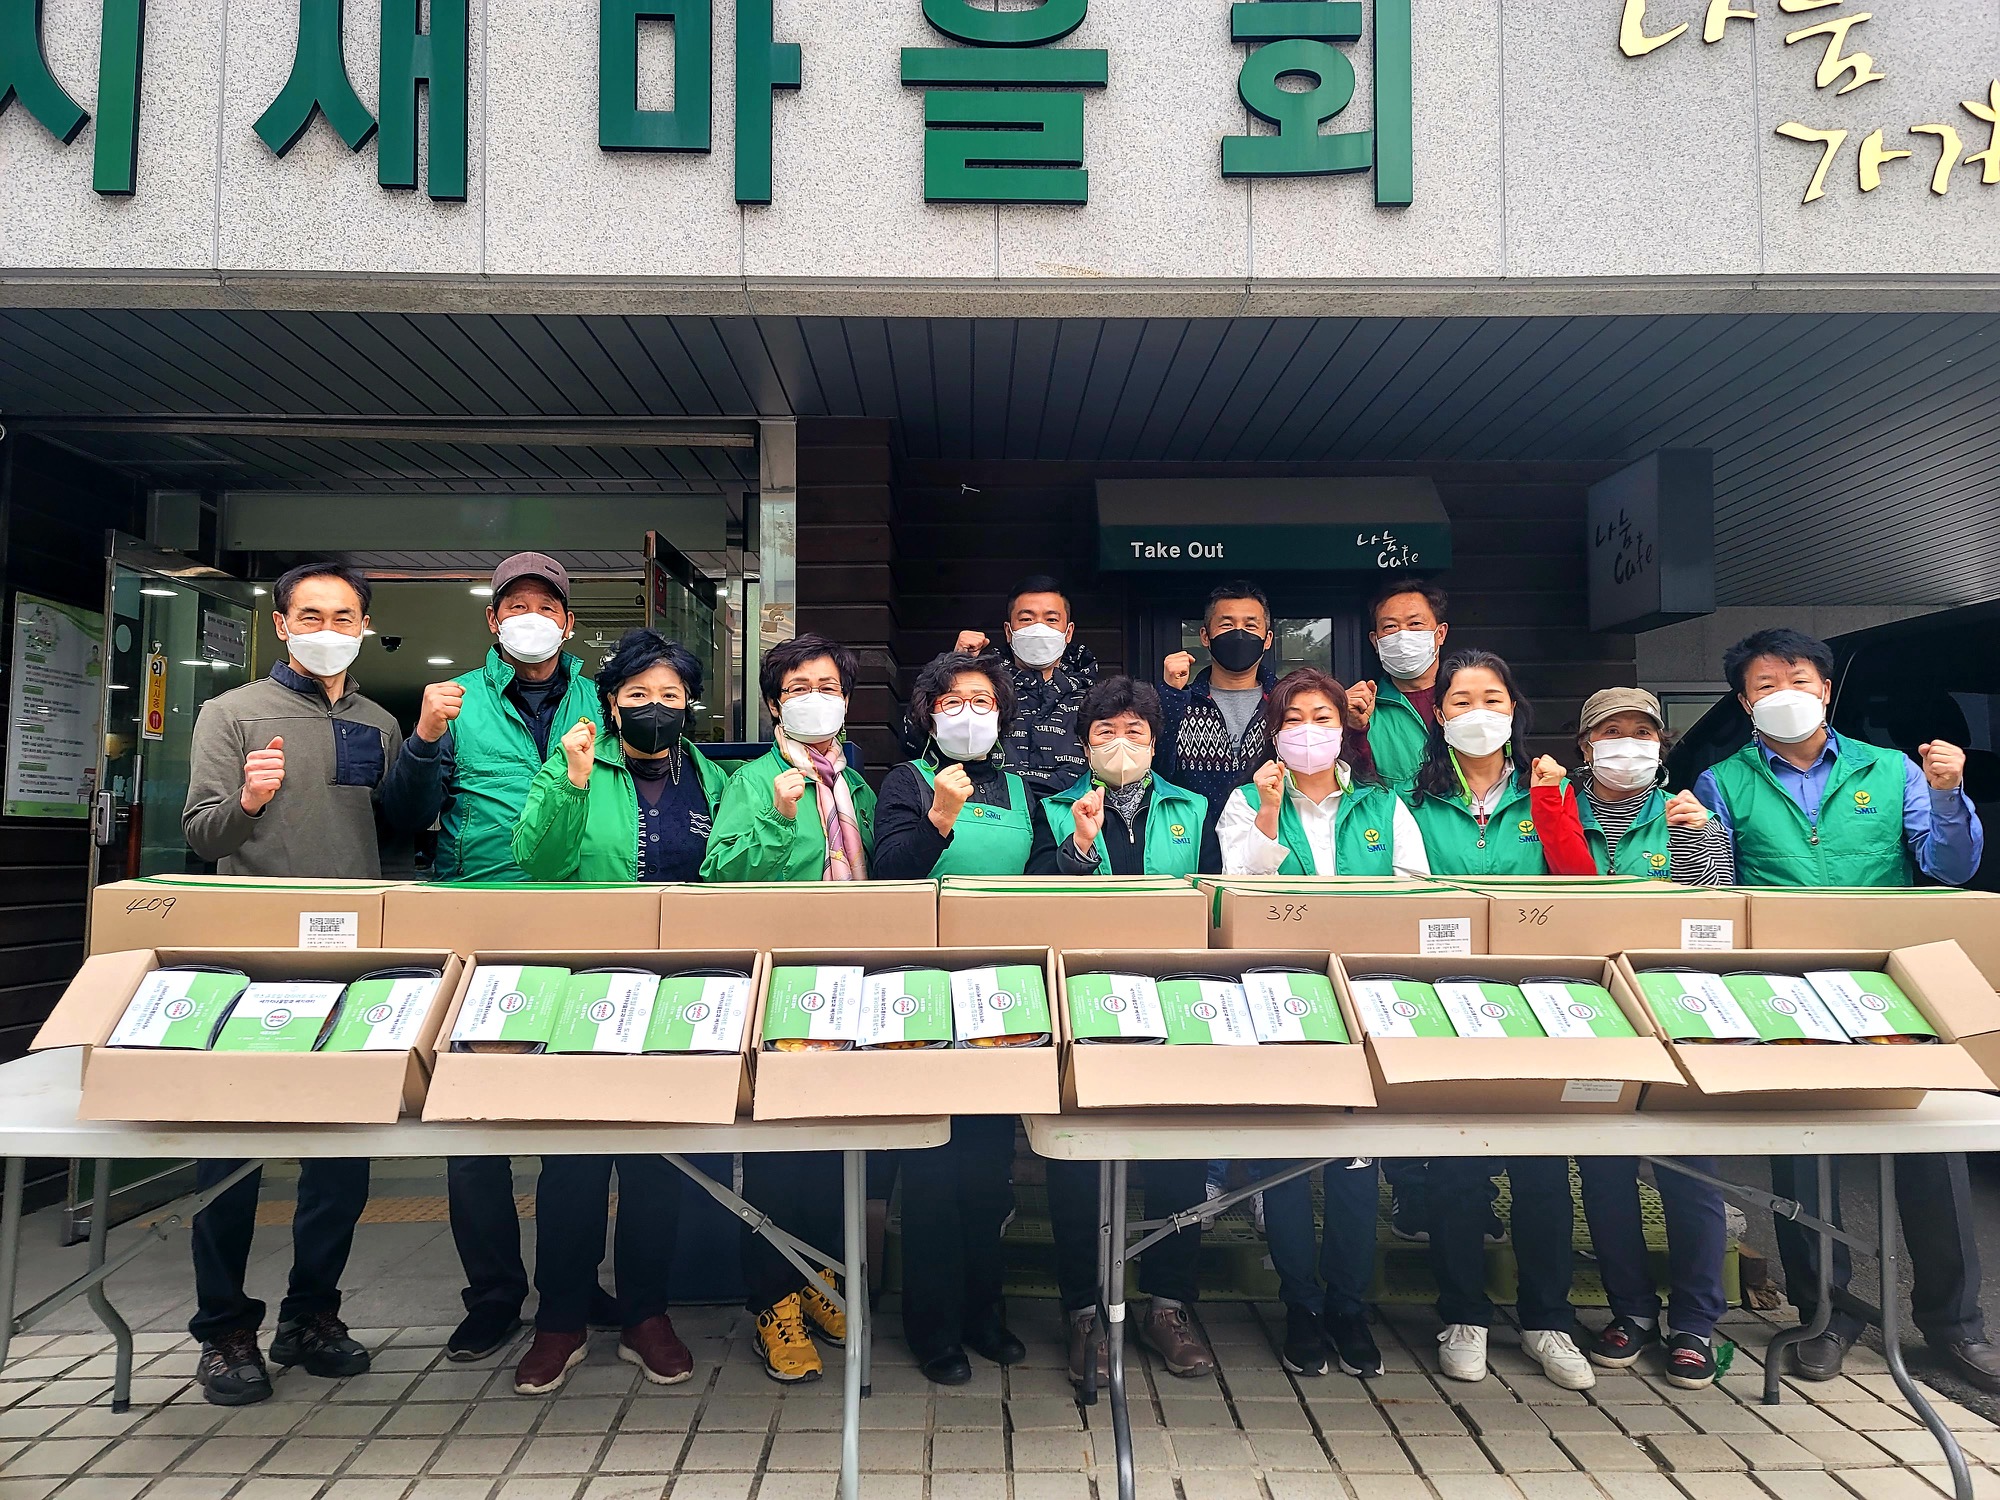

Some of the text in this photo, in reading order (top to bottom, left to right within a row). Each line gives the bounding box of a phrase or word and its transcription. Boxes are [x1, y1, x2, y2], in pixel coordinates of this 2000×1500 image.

[1595, 508, 1633, 550] 나눔
[1130, 541, 1224, 559] Take Out
[1356, 530, 1398, 552] 나눔
[1377, 545, 1419, 568] Cafe
[1614, 532, 1653, 584] Cafe
[1854, 807, 1878, 815] SMU
[1172, 837, 1191, 845] SMU
[1367, 843, 1386, 853] SMU
[1519, 835, 1540, 843] SMU
[1647, 869, 1669, 878] SMU
[126, 897, 177, 919] 409
[1266, 903, 1309, 921] 395
[1518, 904, 1554, 926] 376
